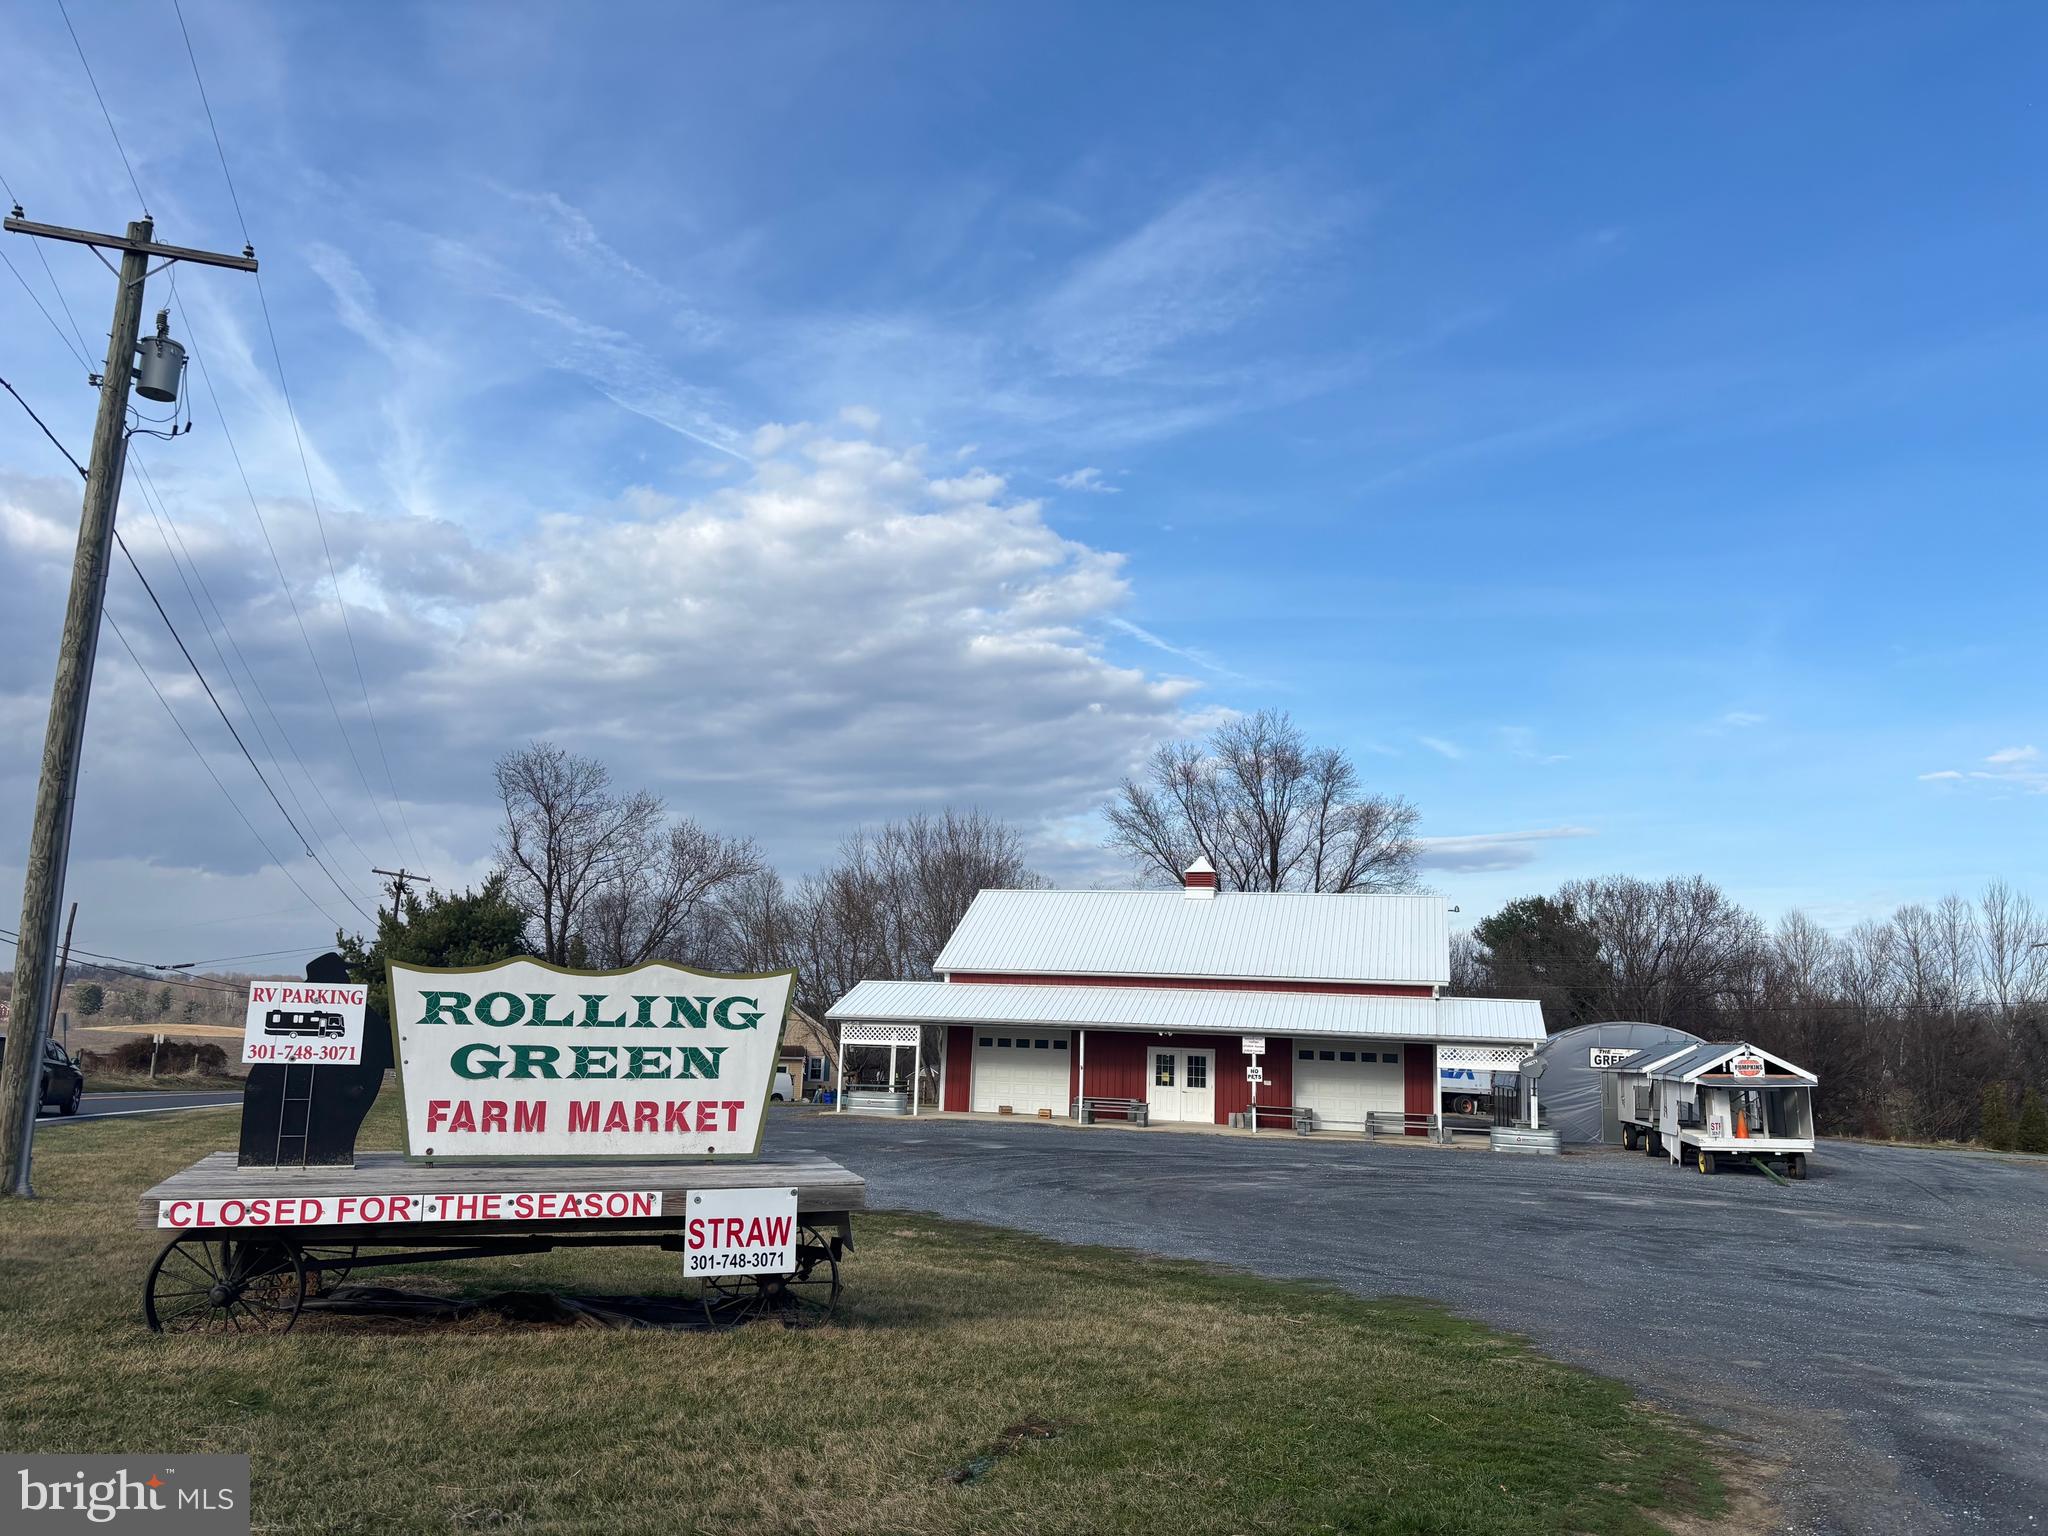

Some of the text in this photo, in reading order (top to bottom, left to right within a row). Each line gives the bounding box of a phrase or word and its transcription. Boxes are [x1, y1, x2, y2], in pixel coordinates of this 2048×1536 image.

[252, 987, 364, 1006] RV PARKING
[415, 990, 767, 1030] ROLLING
[247, 1044, 357, 1061] 301-748-3071
[450, 1043, 729, 1080] GREEN
[1594, 1054, 1630, 1066] GRE
[426, 1100, 745, 1133] FARM MARKET
[168, 1192, 654, 1227] CLOSED FOR THE SEASON
[687, 1215, 793, 1250] STRAW
[690, 1251, 785, 1271] 301-748-3071
